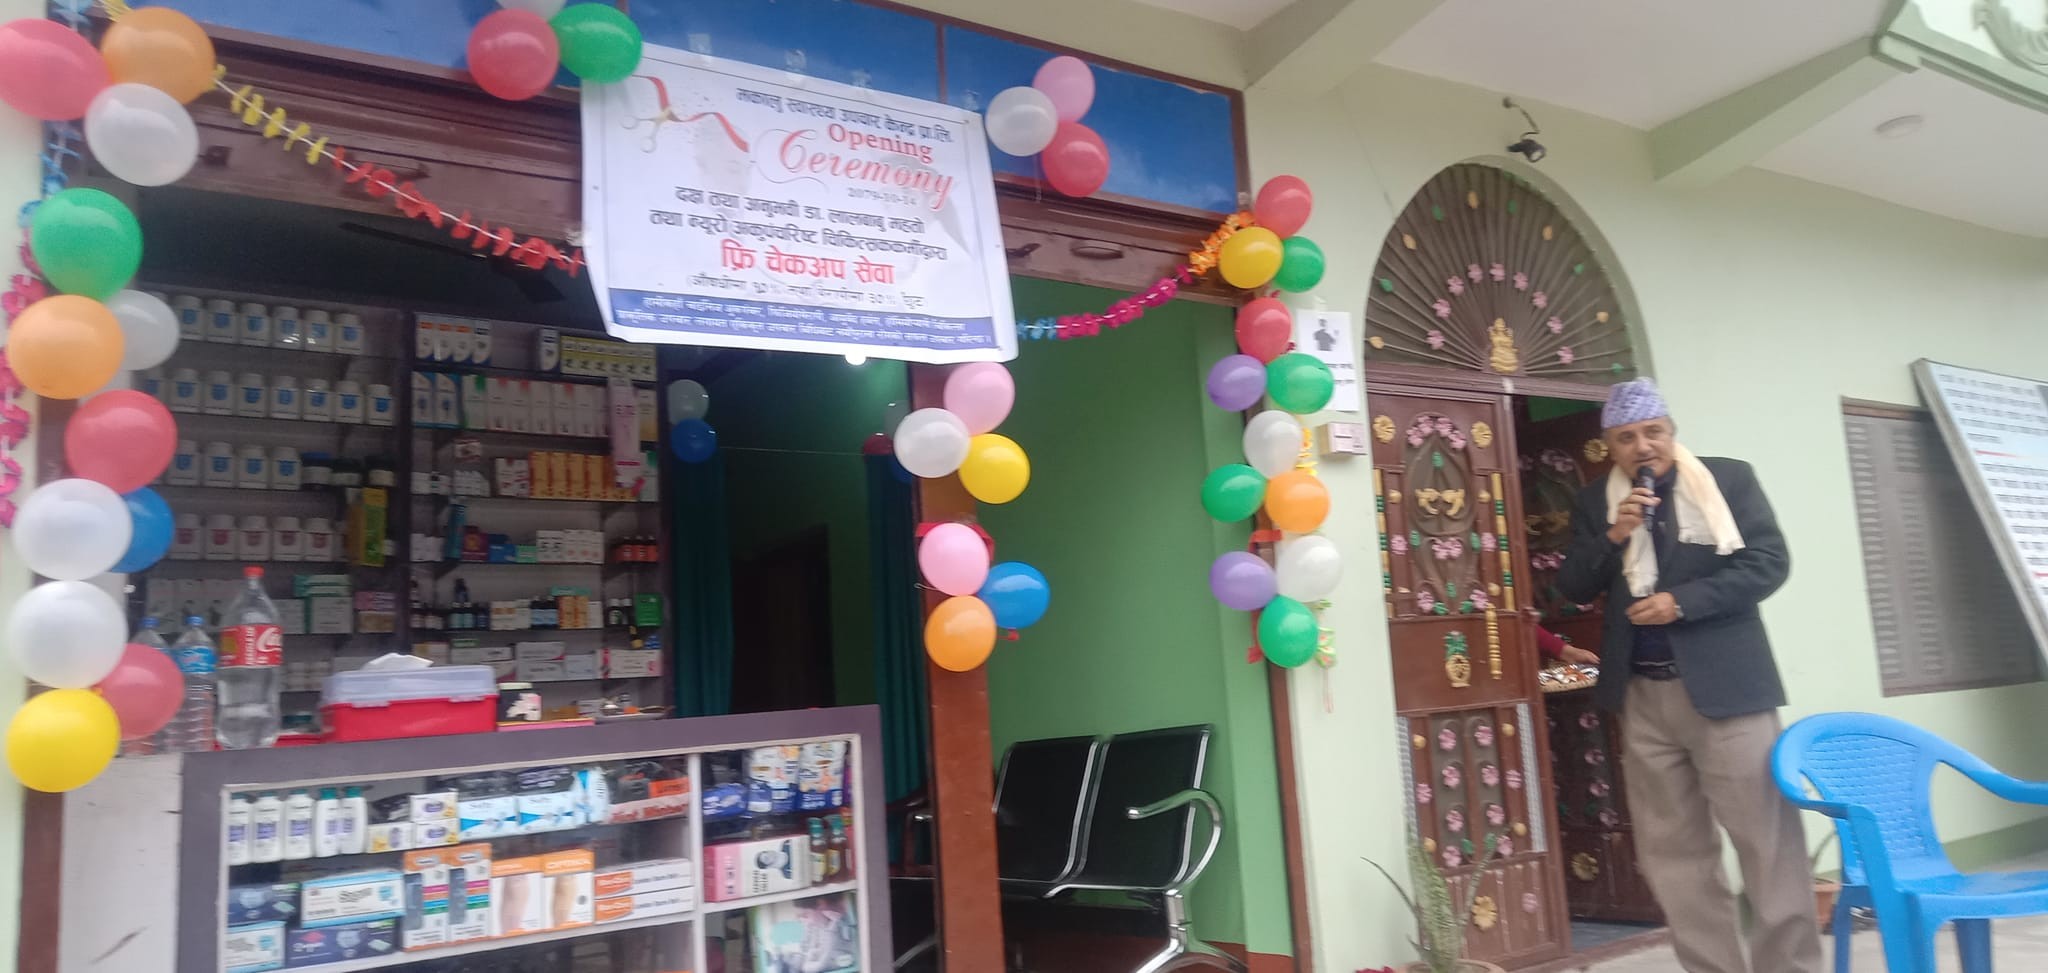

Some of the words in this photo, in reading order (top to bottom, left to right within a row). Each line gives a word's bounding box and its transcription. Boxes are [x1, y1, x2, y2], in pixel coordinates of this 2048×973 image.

[735, 88, 784, 113] मकालु
[838, 108, 881, 129] उपचार
[827, 122, 934, 164] Opening
[779, 128, 953, 211] Ceremony
[649, 209, 684, 227] तथा
[687, 213, 729, 236] न्यूरो
[708, 191, 740, 209] तथा
[743, 197, 801, 219] अनुभवी
[804, 206, 825, 221] डा.
[828, 208, 888, 233] लालबाबु
[888, 217, 926, 234] महतो
[721, 238, 758, 271] फ्रि
[764, 244, 846, 280] चेकअप
[853, 254, 895, 285] सेवा
